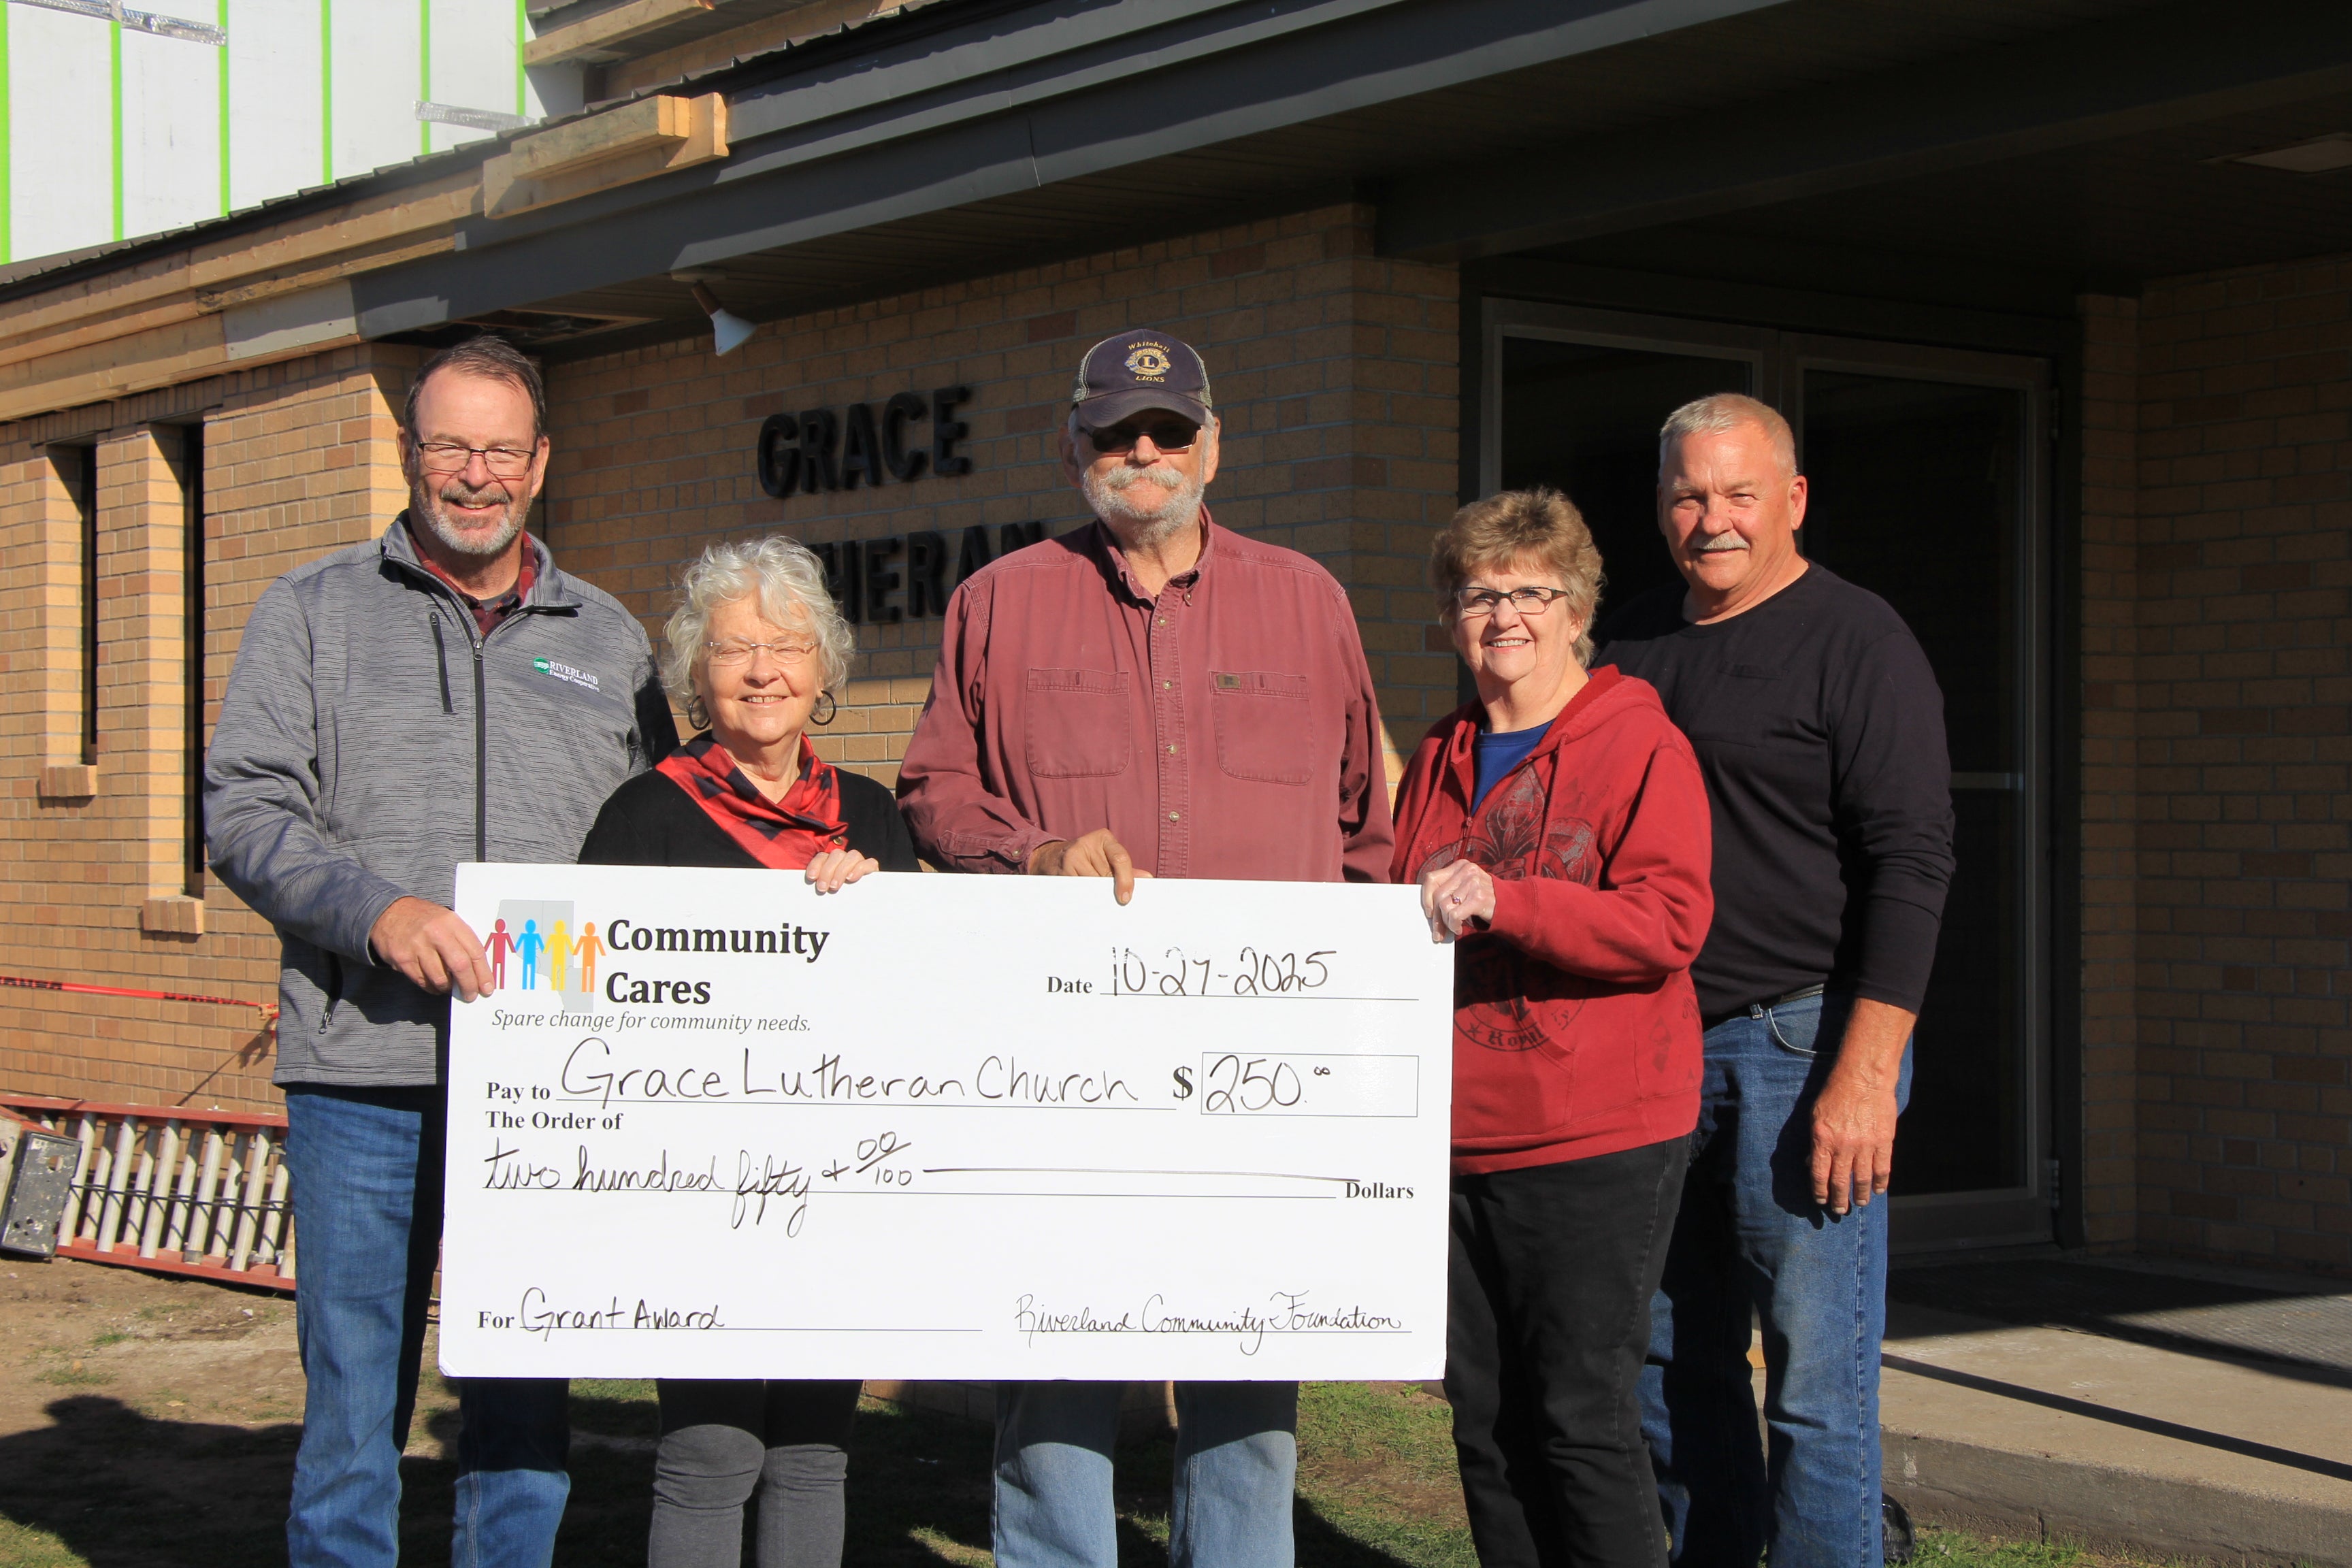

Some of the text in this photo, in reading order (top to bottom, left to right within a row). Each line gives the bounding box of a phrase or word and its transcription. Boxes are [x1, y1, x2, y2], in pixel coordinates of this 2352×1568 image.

[757, 386, 973, 498] GRACE
[549, 661, 598, 685] RIVERLAND
[607, 919, 830, 963] Community
[606, 971, 712, 1004] Cares
[1047, 977, 1093, 994] Date
[491, 1009, 811, 1034] Spare change for community needs.
[561, 1036, 1139, 1109] Grace Lutheran Church
[485, 1081, 551, 1104] Pay to
[485, 1111, 624, 1130] The Order of
[483, 1137, 560, 1190] two
[573, 1145, 725, 1192] hundred
[732, 1149, 812, 1238] fifty
[1345, 1182, 1414, 1200] Dollars
[478, 1310, 515, 1329] For
[521, 1287, 726, 1342] Grant Award
[1016, 1290, 1402, 1356] Riverland Community Foundation
